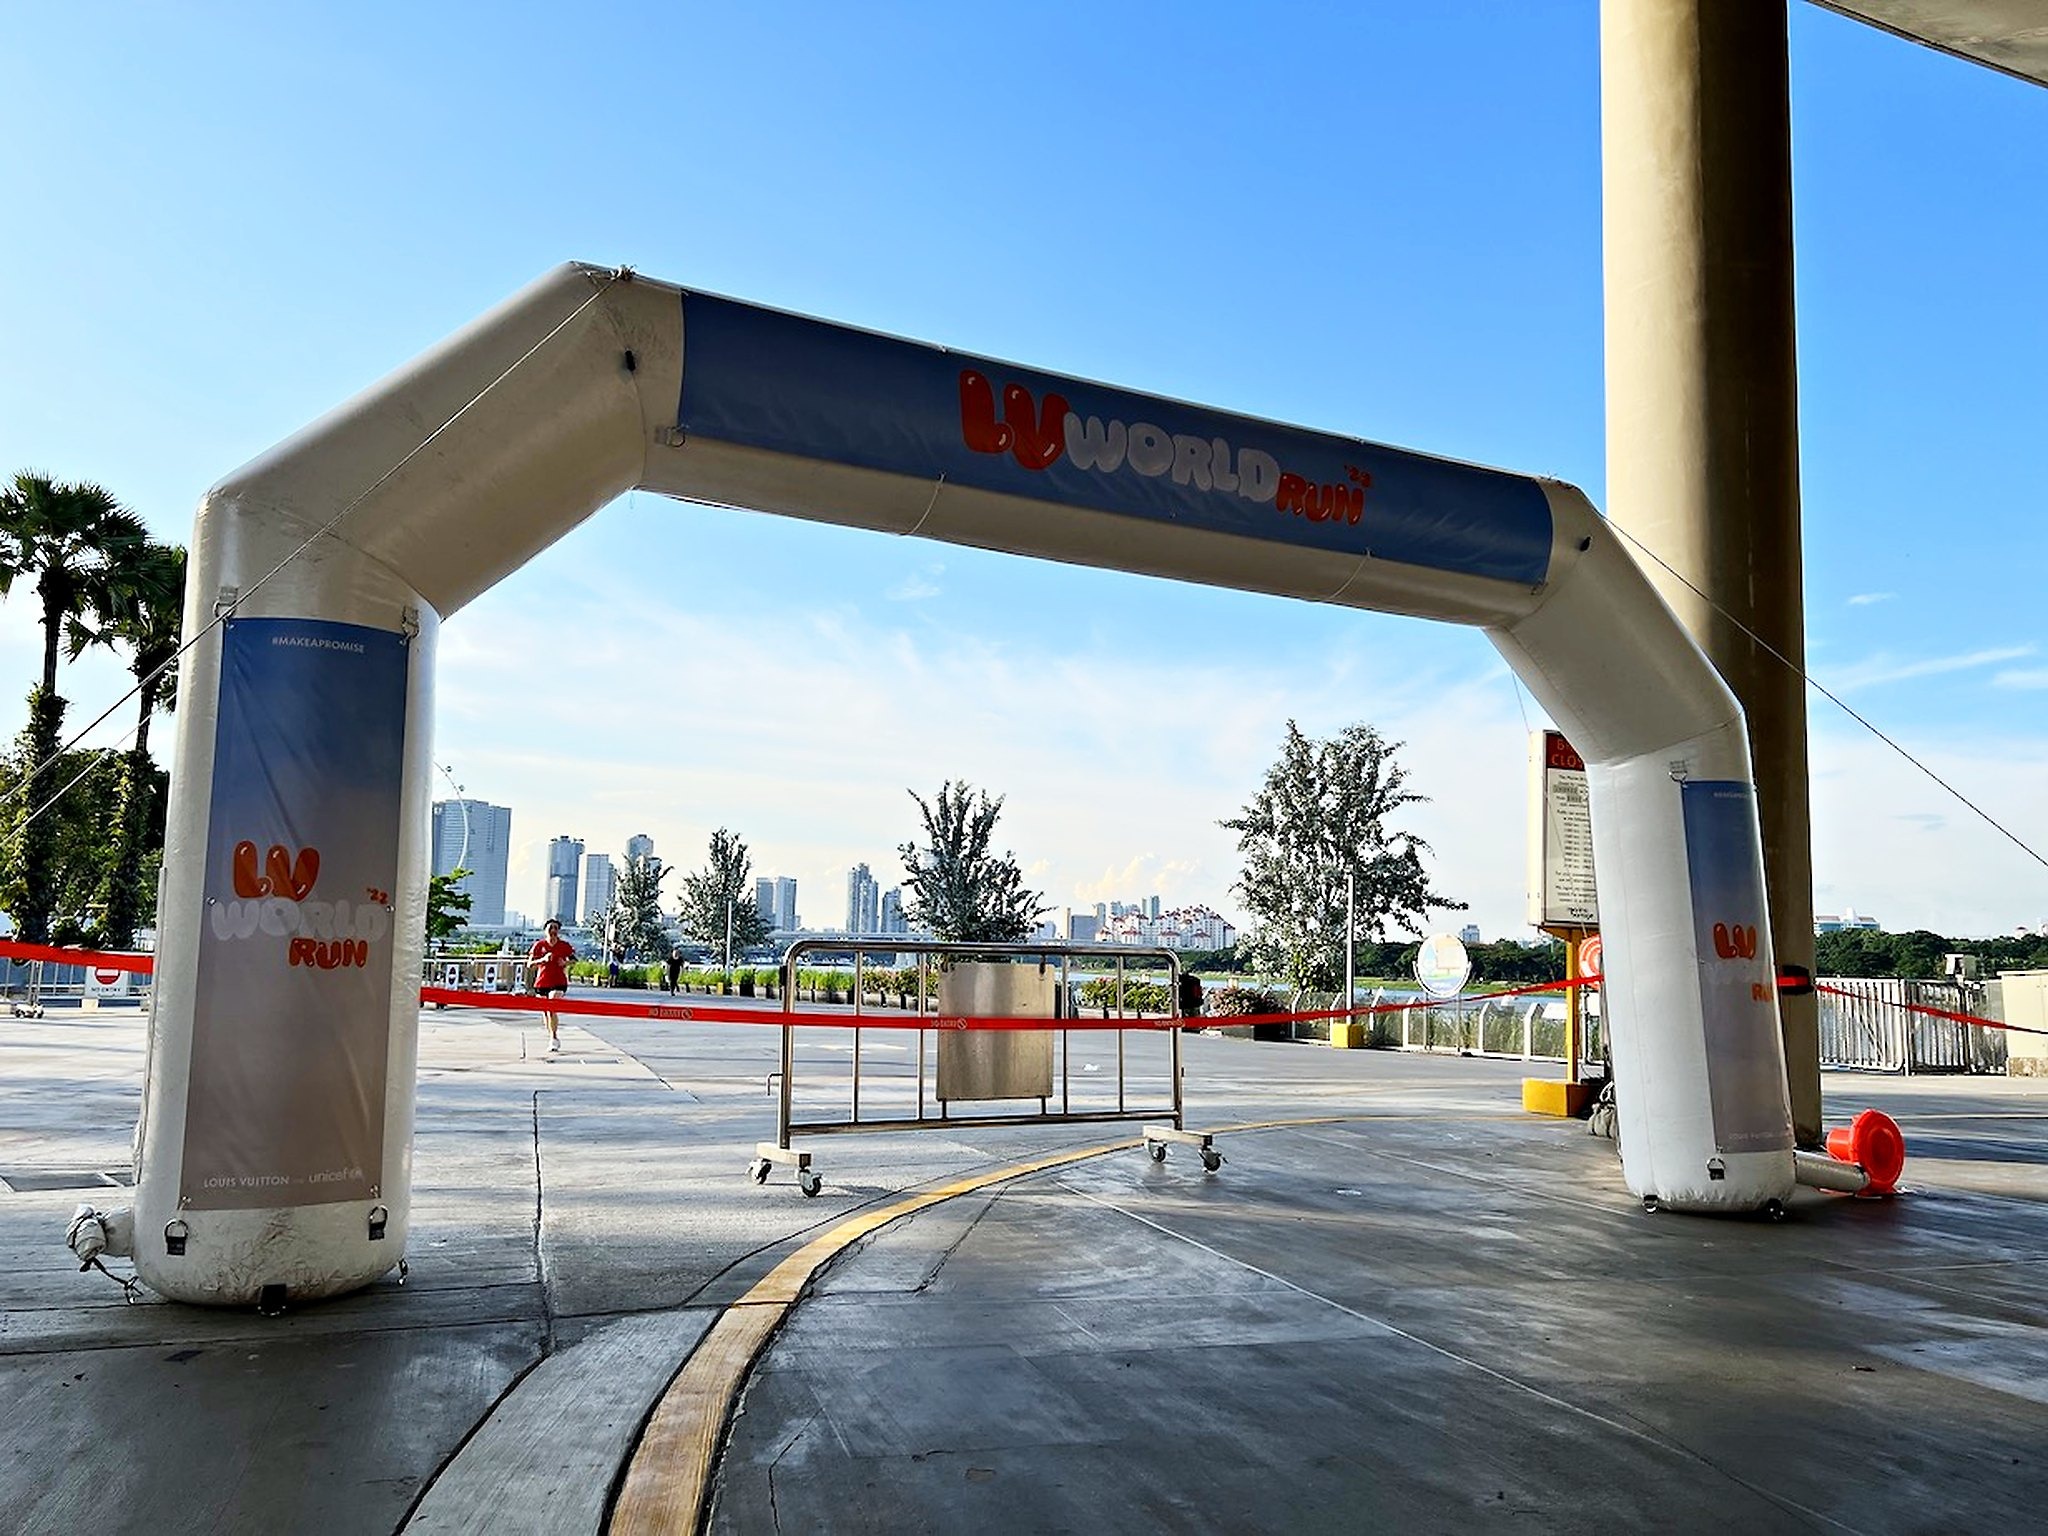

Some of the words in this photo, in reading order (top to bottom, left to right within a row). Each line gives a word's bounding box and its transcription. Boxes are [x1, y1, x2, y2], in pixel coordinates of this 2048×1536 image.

[1064, 411, 1280, 503] WORLD
[1276, 472, 1364, 526] RUN
[271, 637, 365, 653] #MAKEAPROMISE
[211, 897, 388, 941] WORLD
[289, 937, 368, 970] RUN
[203, 1177, 236, 1188] LOUIS
[239, 1175, 290, 1186] VUITTON
[308, 1167, 348, 1183] unicef
